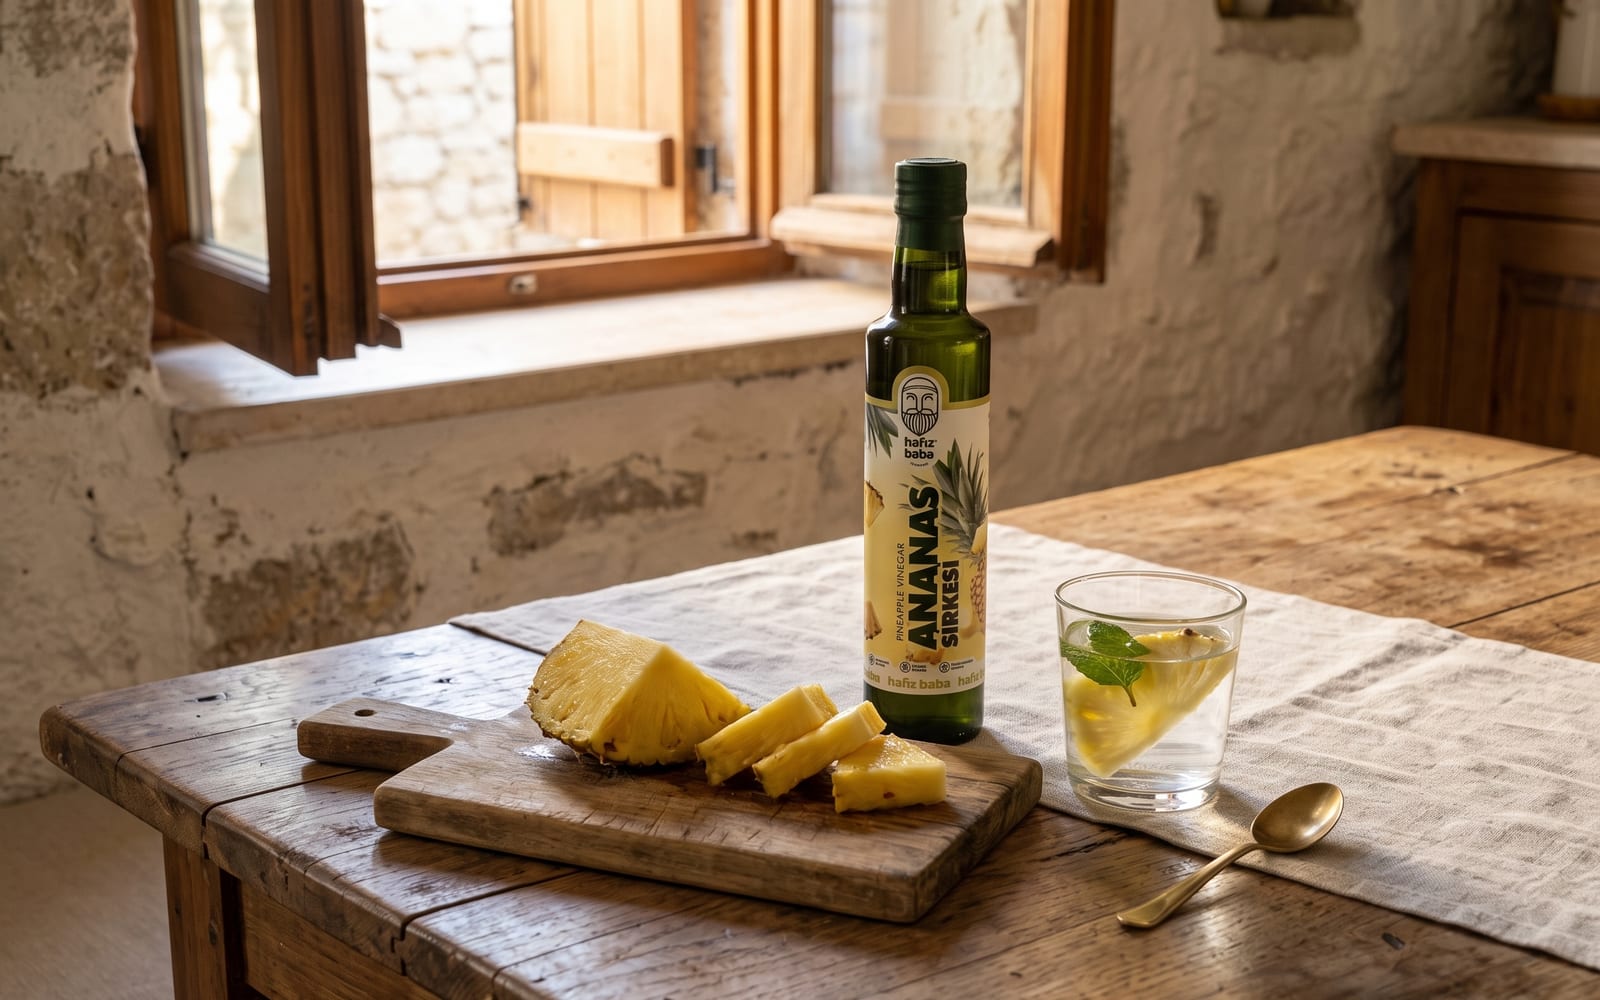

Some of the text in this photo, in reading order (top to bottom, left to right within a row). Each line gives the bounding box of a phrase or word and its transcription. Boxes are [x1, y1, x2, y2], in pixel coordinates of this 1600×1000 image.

[904, 448, 934, 459] baba
[896, 543, 905, 642] PINEAPPLE VINEGAR
[908, 486, 939, 650] ANANAS
[919, 679, 951, 689] baba
